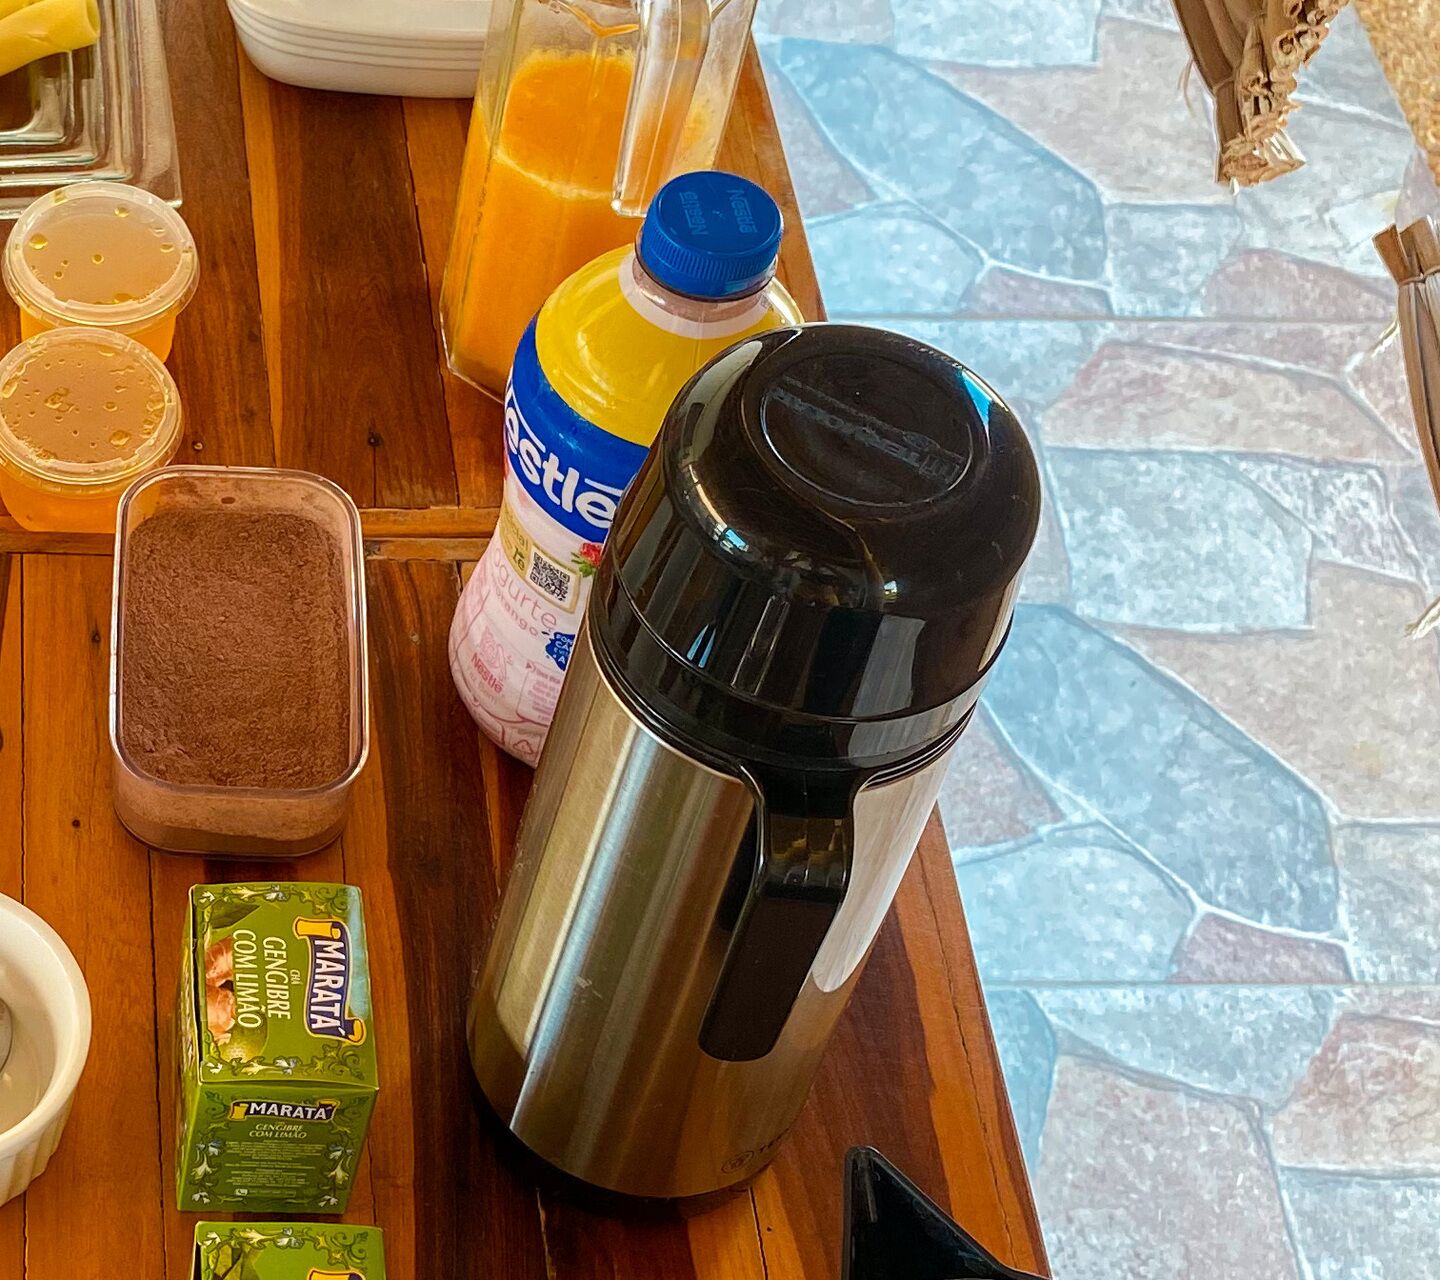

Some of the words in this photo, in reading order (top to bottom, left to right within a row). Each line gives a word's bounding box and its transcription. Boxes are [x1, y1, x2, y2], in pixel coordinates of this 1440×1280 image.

[232, 929, 258, 970] COM
[262, 936, 291, 1020] GENGIBRE
[235, 971, 265, 1029] LIMÃO
[310, 939, 346, 1040] MARATÁ
[249, 1101, 333, 1121] MARATÁ
